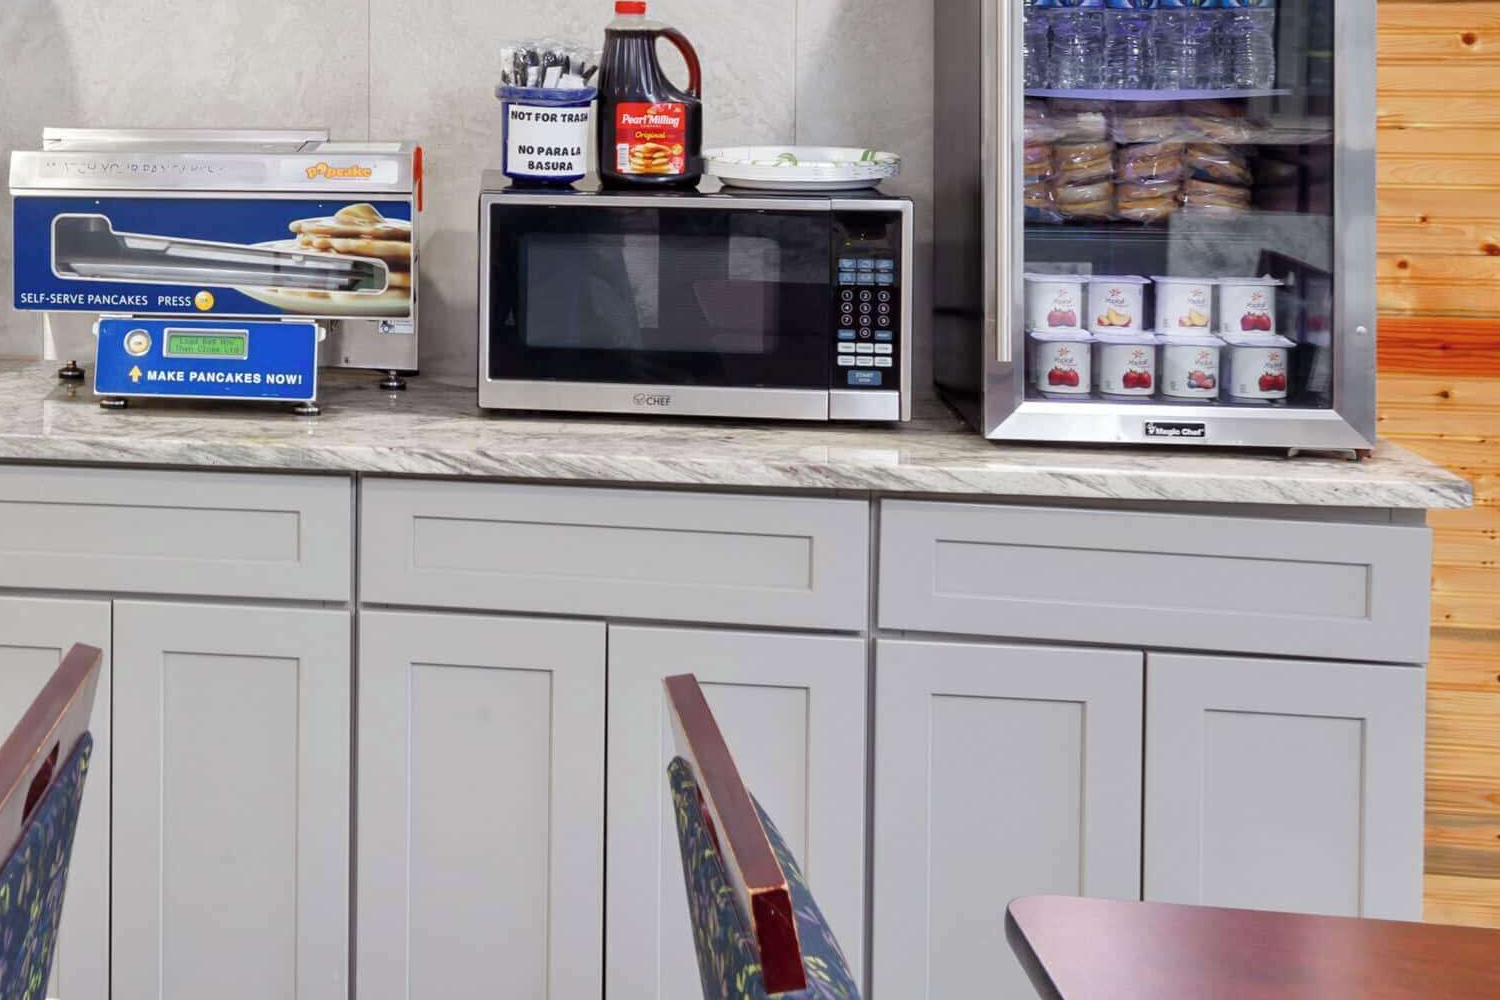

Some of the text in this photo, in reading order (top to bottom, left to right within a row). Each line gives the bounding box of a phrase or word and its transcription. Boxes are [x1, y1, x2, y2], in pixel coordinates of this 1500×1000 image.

[511, 111, 588, 122] NOT FOR TRASH
[622, 113, 680, 128] Pearl Milling
[635, 131, 666, 140] Original
[518, 145, 581, 156] NO PARA LA
[528, 160, 573, 171] BASURA
[20, 293, 84, 305] SELF-SERVE
[87, 294, 148, 306] PANCAKES
[158, 295, 192, 307] PRESS
[147, 370, 302, 385] MAKE PANCAKES NOW!
[646, 396, 671, 406] CHEF
